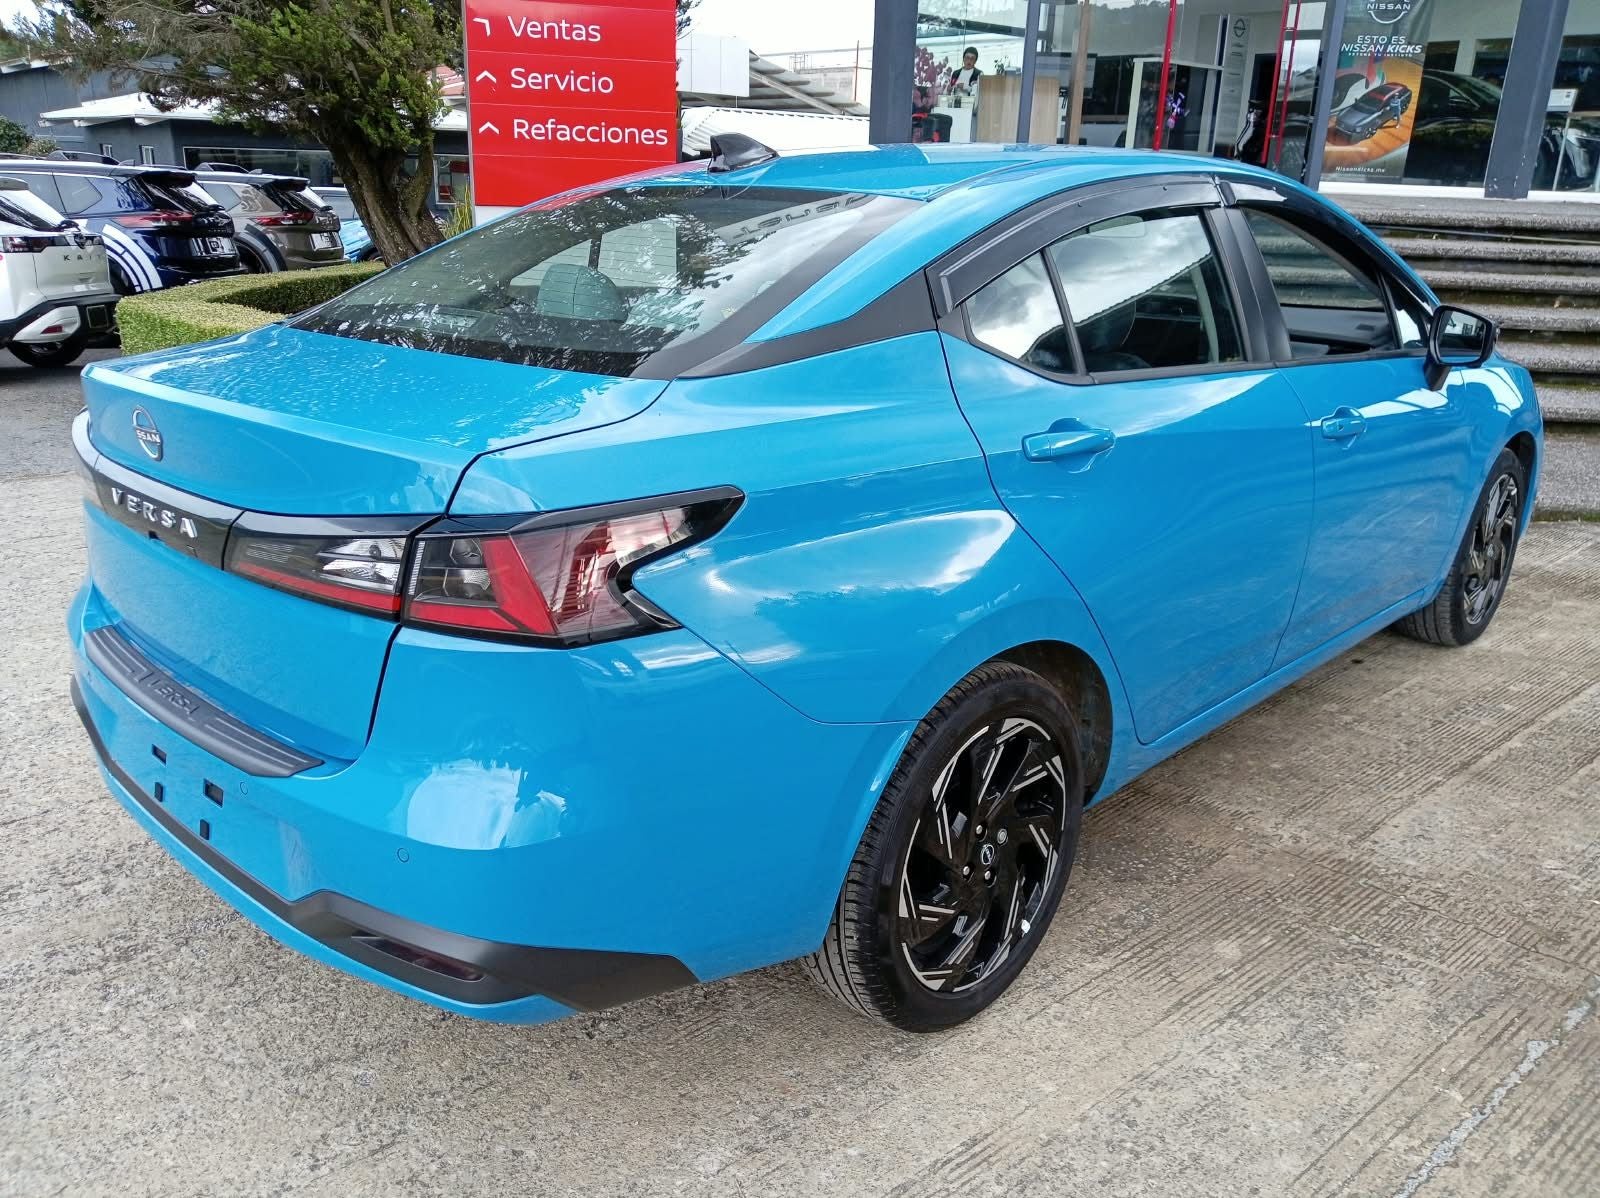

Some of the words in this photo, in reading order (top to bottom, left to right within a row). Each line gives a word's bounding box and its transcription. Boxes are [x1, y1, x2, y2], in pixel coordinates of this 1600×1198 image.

[507, 15, 601, 42] Ventas
[1357, 35, 1387, 44] ESTO
[1391, 36, 1406, 44] ES
[1341, 43, 1384, 52] NISSAN
[1386, 45, 1422, 53] KICKS
[510, 67, 614, 93] Servicio
[513, 118, 668, 146] Refacciones
[111, 487, 198, 538] VERSA
[131, 670, 201, 720] VERSA
